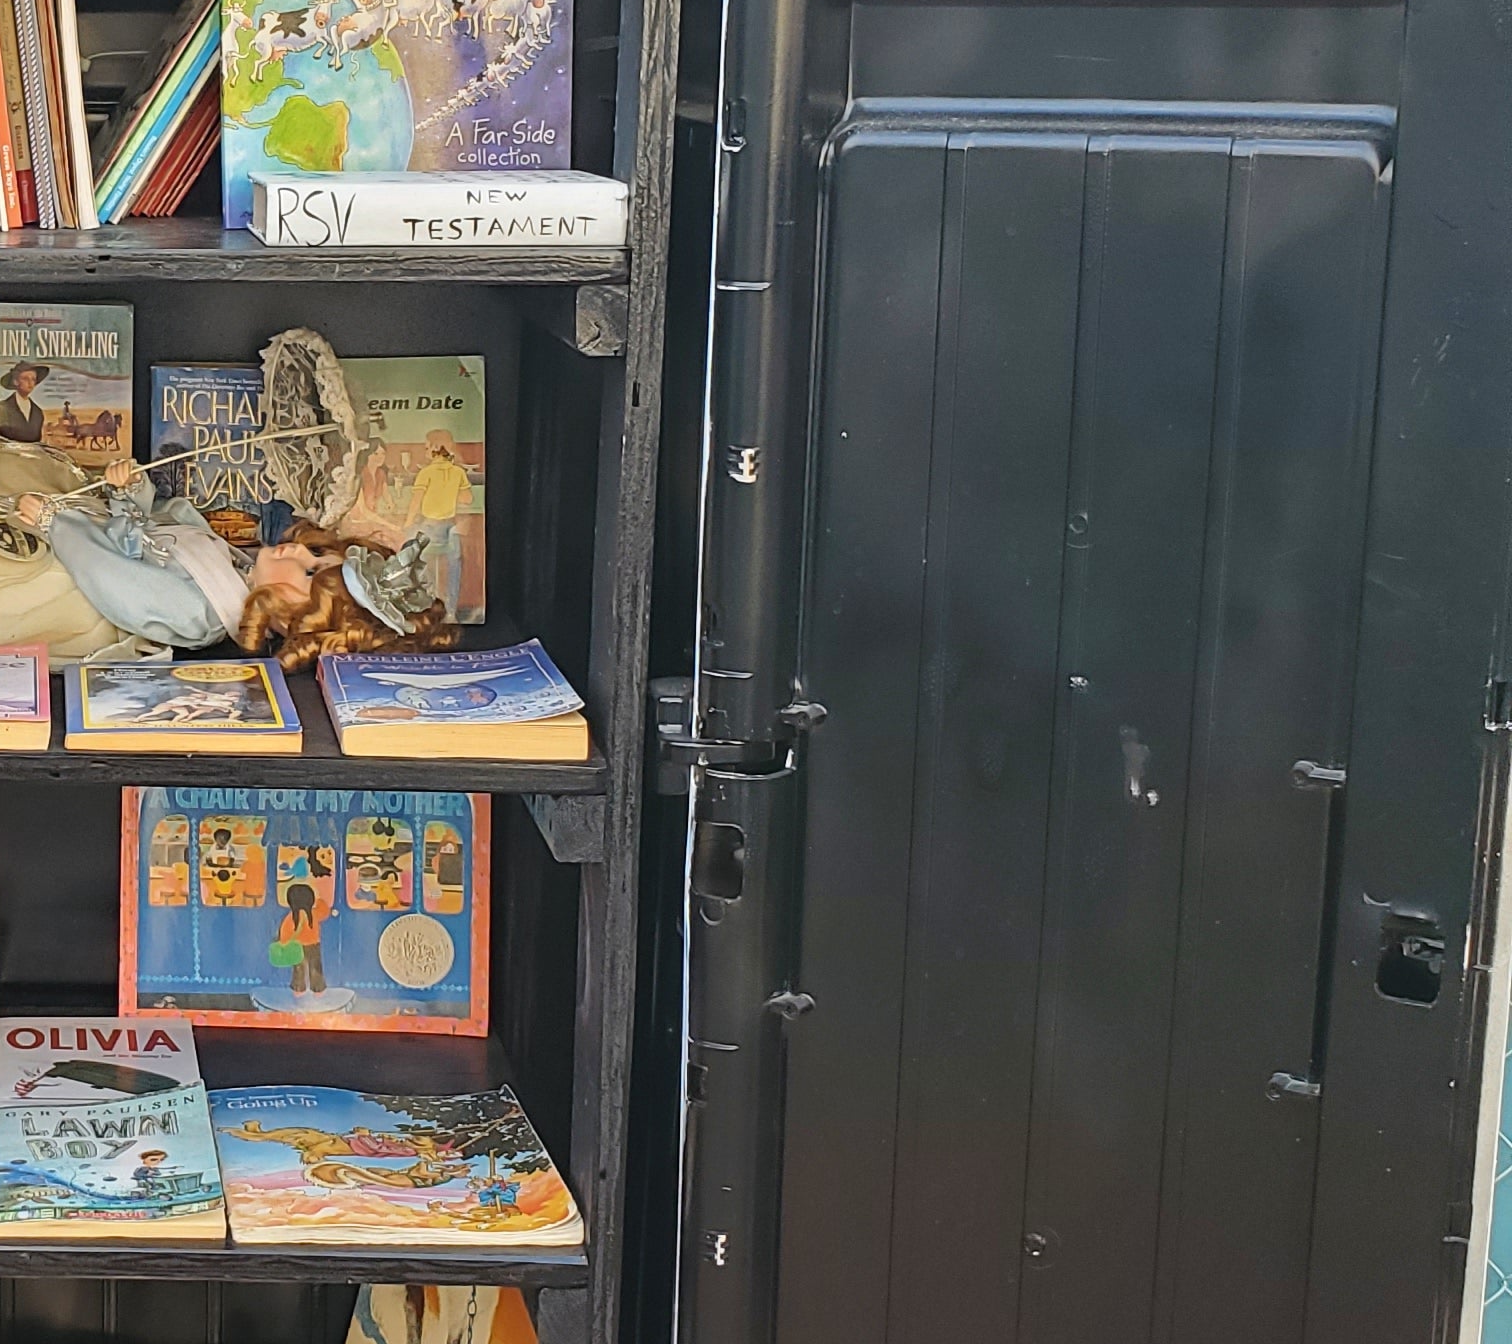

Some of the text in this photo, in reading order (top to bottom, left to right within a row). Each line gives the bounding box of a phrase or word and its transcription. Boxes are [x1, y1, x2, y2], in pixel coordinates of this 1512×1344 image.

[444, 118, 557, 147] A Far Side
[457, 148, 542, 167] collection
[277, 186, 528, 247] RSV NEW
[402, 215, 600, 241] TESTAMENT
[35, 327, 120, 359] SNELLING
[192, 425, 266, 465] PAUL
[184, 461, 274, 508] EVANS
[150, 788, 466, 817] A CHAIR FOR MY MOTHER
[6, 1027, 181, 1053] OLIVIA
[4, 1094, 196, 1118] GARY PAULSEN
[227, 1097, 319, 1110] Going Up
[21, 1109, 180, 1139] LAWN
[25, 1138, 139, 1161] BOY
